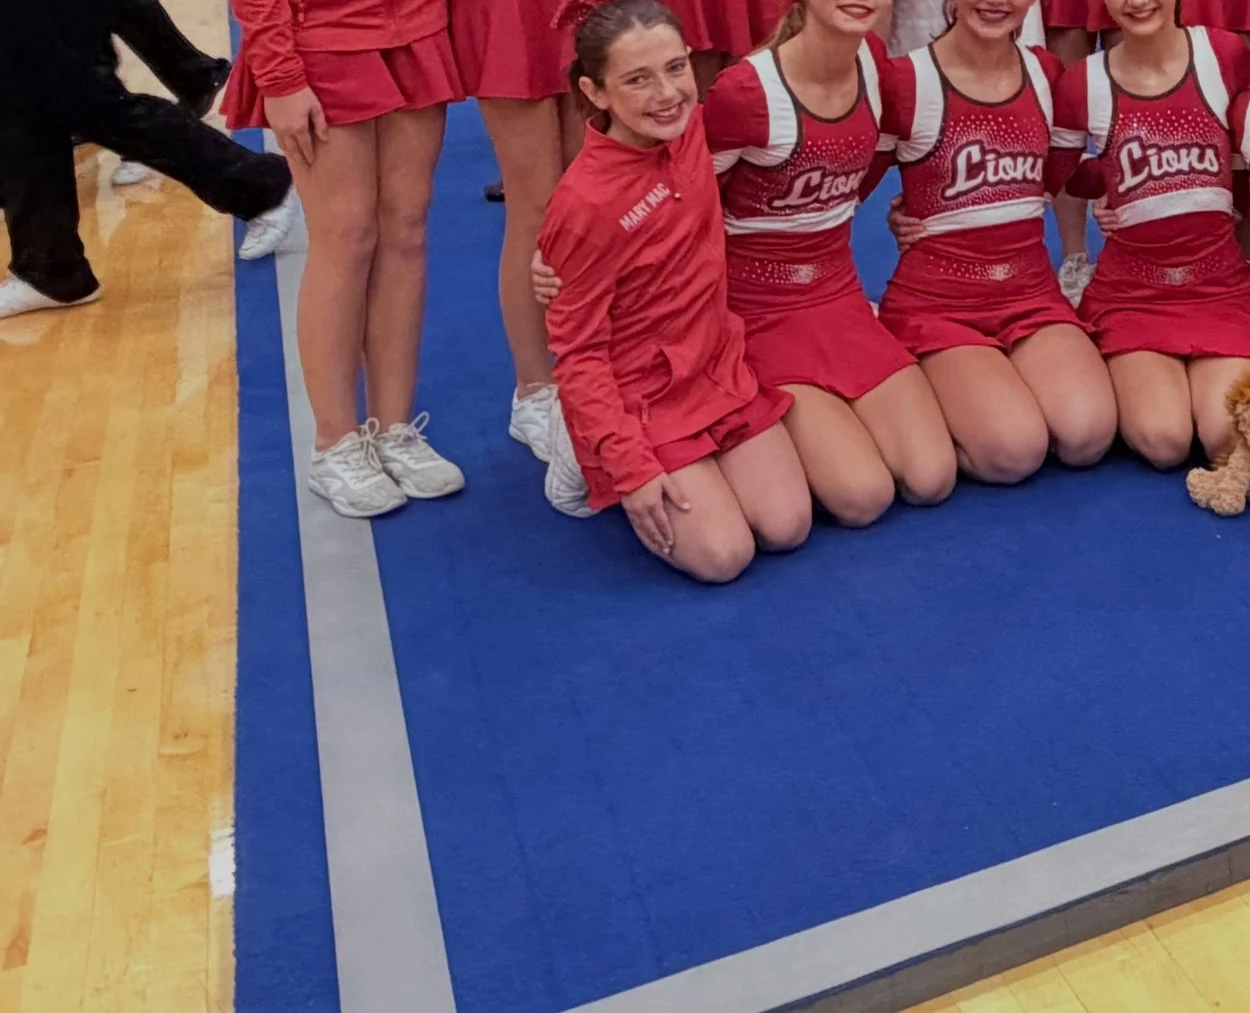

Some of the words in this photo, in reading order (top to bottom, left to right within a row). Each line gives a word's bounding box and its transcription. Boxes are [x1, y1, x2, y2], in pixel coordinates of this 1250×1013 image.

[772, 170, 867, 207] Lion
[1118, 140, 1220, 194] Lions
[619, 200, 652, 233] MARY
[646, 182, 671, 210] MAC
